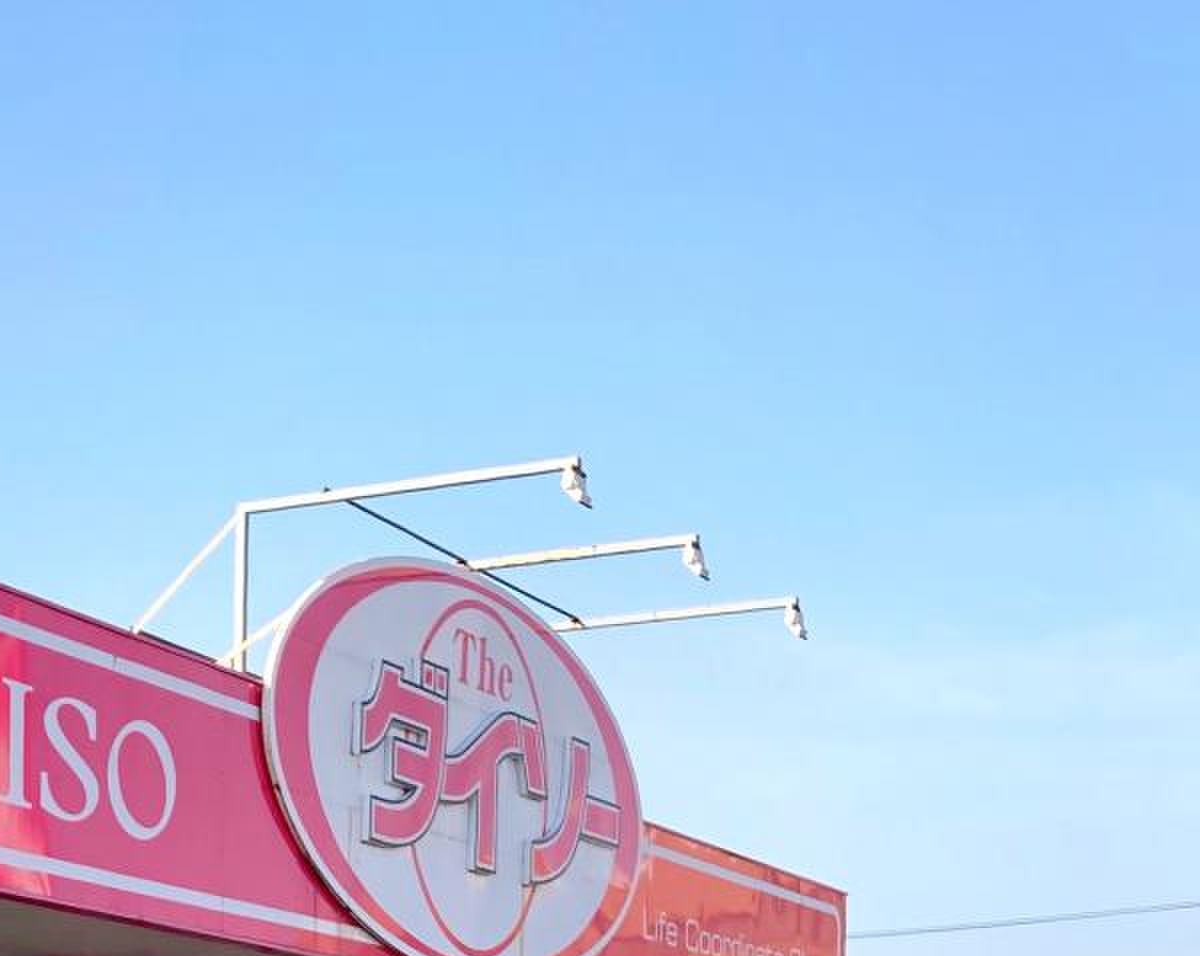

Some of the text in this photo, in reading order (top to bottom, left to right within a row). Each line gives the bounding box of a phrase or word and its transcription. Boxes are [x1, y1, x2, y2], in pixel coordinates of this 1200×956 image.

[452, 627, 514, 702] The
[351, 658, 622, 888] ダイソー
[642, 895, 679, 948] Life
